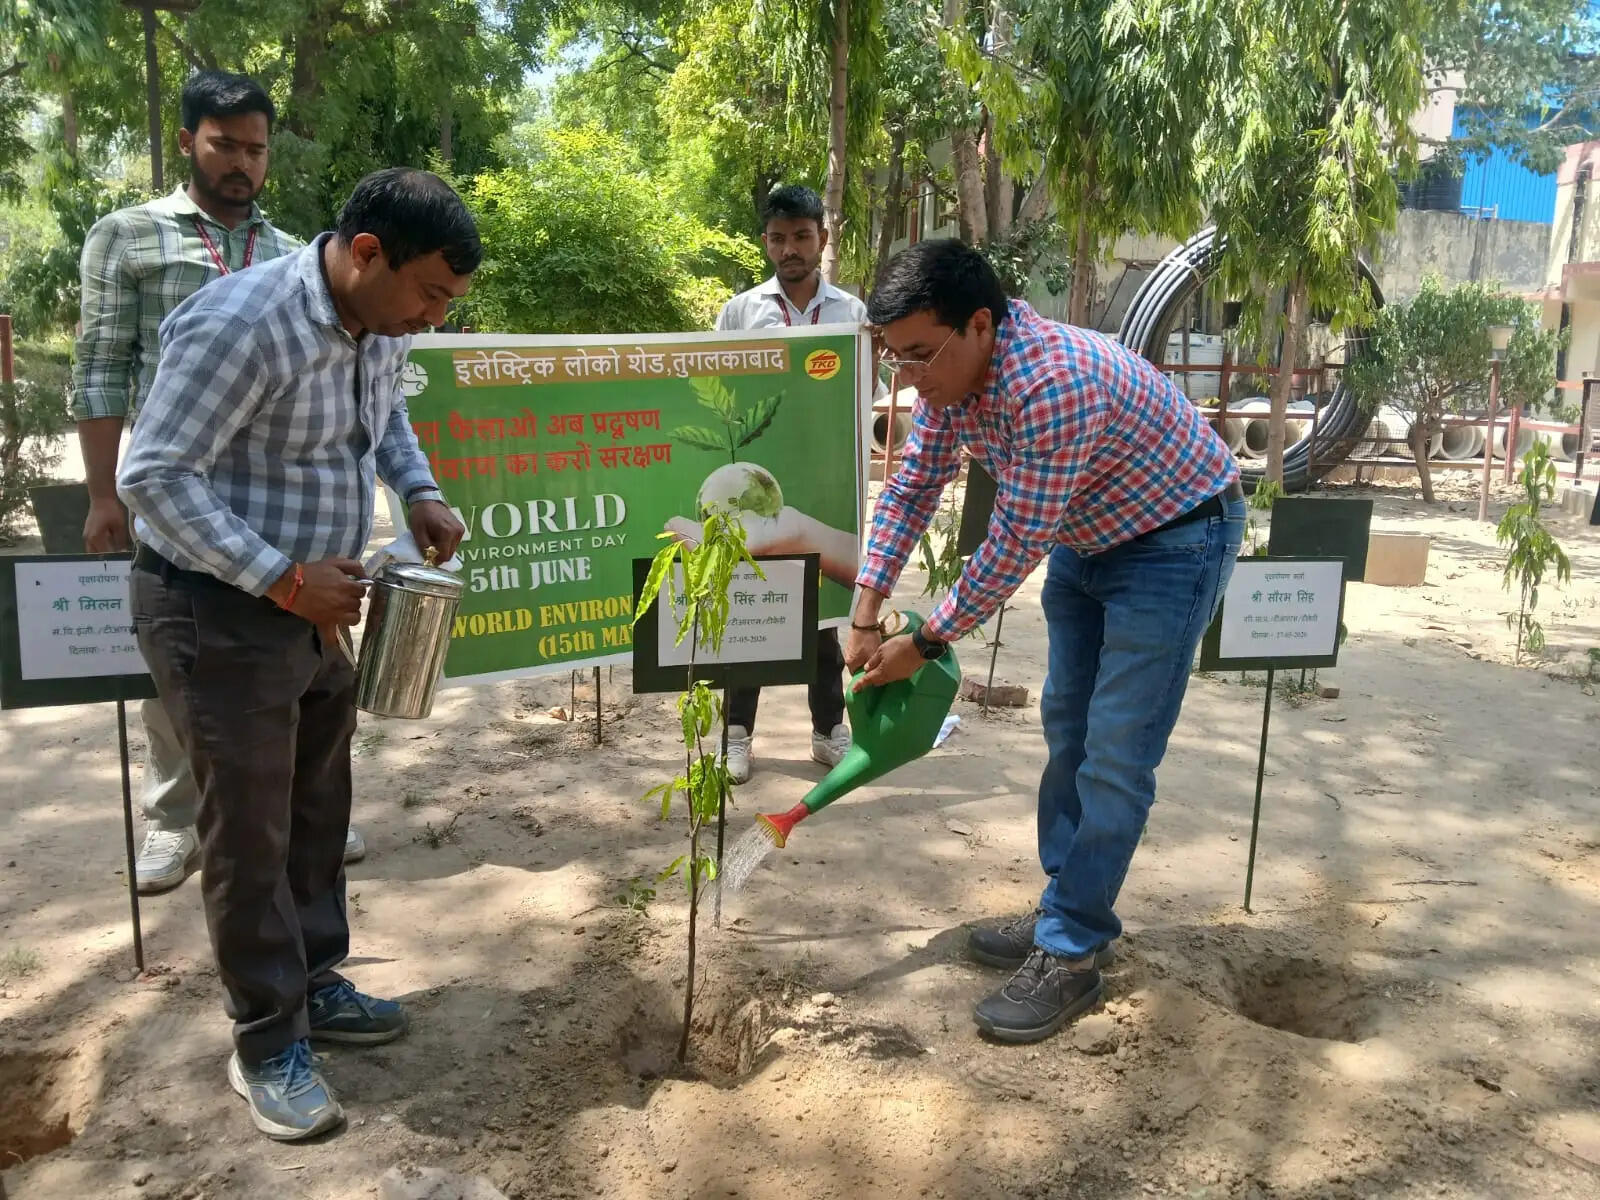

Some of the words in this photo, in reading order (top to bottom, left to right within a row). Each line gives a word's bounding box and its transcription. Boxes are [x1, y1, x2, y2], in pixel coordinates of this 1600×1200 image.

[453, 350, 556, 385] इलेक्ट्रिक
[562, 348, 620, 377] लोको
[811, 360, 836, 369] TKD
[447, 407, 538, 443] फैलाओ
[546, 413, 585, 436] अब
[589, 409, 661, 440] प्रदूषण
[504, 452, 538, 477] का
[597, 441, 673, 469] संरक्षण
[456, 538, 583, 561] NVIRONMENT
[592, 533, 627, 549] DAY
[470, 565, 521, 593] 5th
[529, 556, 592, 590] JUNE
[52, 596, 70, 612] श्री
[78, 595, 122, 611] मिलन
[733, 591, 757, 606] सिंह
[761, 590, 789, 605] मीना
[450, 608, 533, 639] WORLD
[538, 629, 595, 659] (15th
[601, 624, 633, 648] MA
